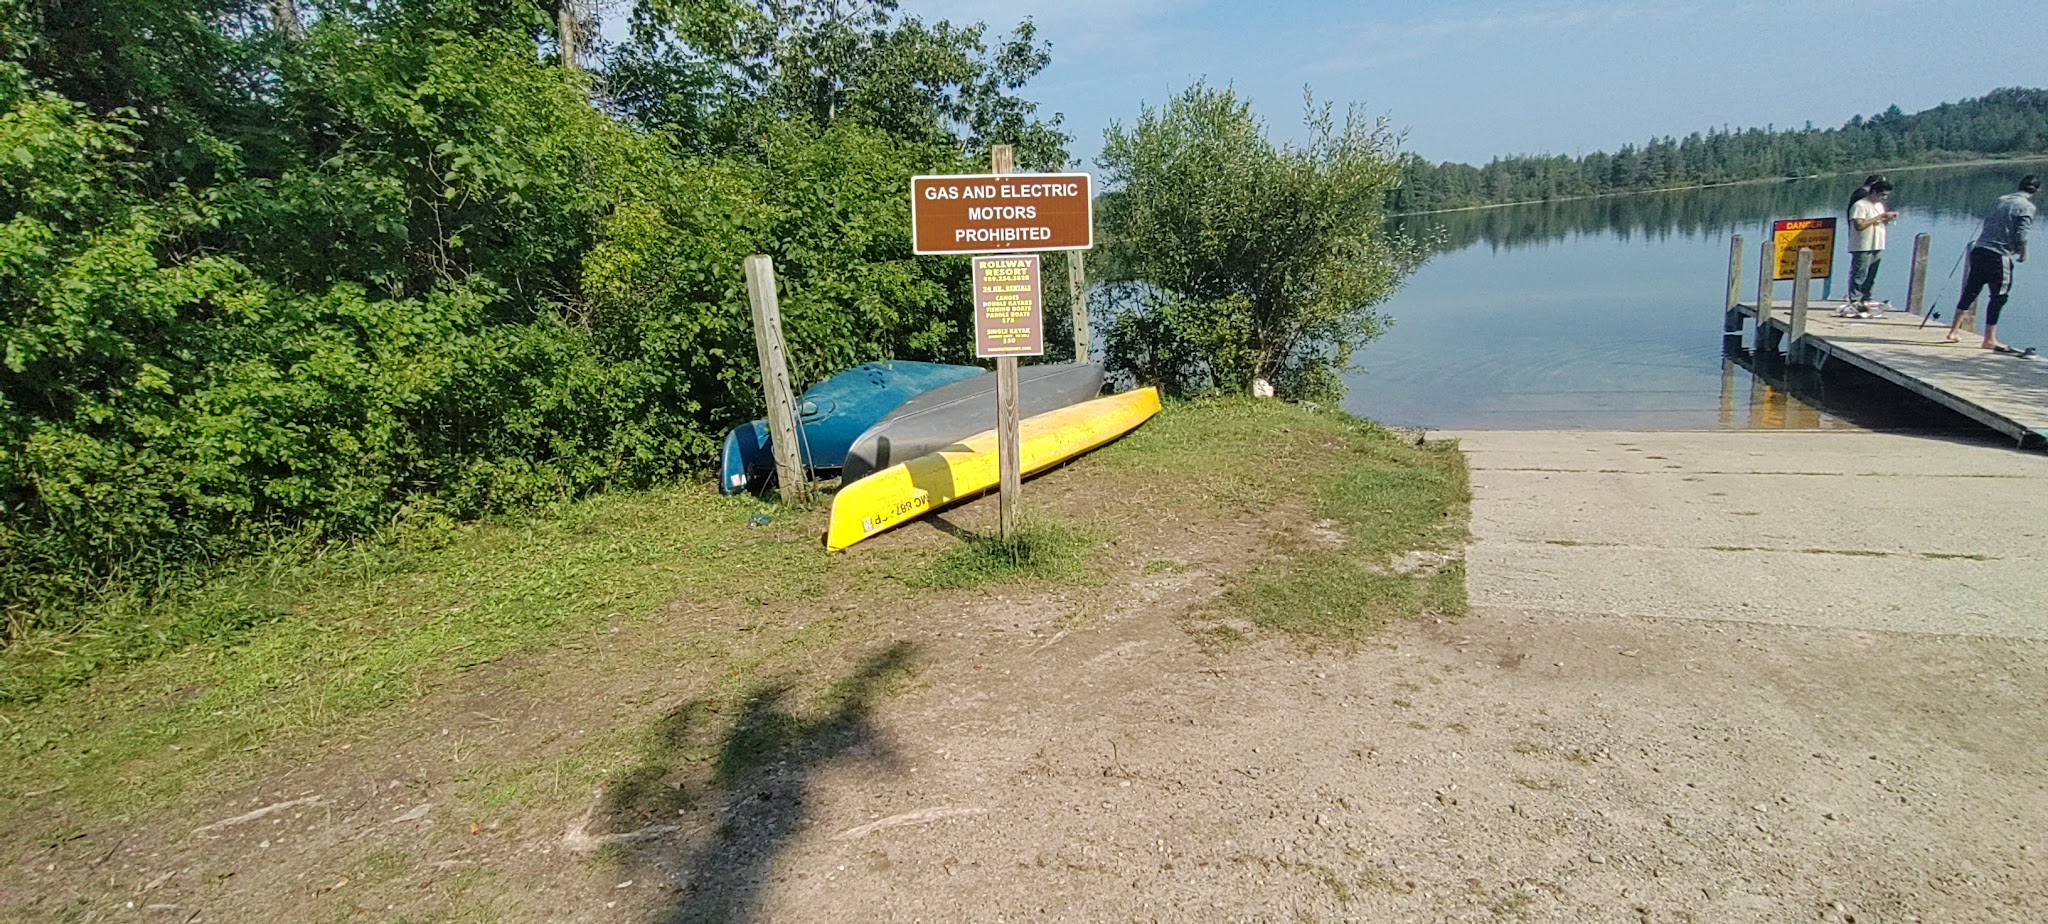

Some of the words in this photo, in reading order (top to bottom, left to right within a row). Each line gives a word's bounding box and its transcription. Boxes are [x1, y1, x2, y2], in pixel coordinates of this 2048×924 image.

[925, 186, 959, 200] GAS
[963, 185, 997, 199] AND
[1001, 183, 1078, 198] ELECTRIC
[968, 206, 1037, 221] MOTORS
[1786, 221, 1822, 230] DANGER
[955, 227, 1051, 242] PROHIBITED
[980, 260, 1032, 268] ROLLWAY
[985, 268, 1028, 276] RESORT
